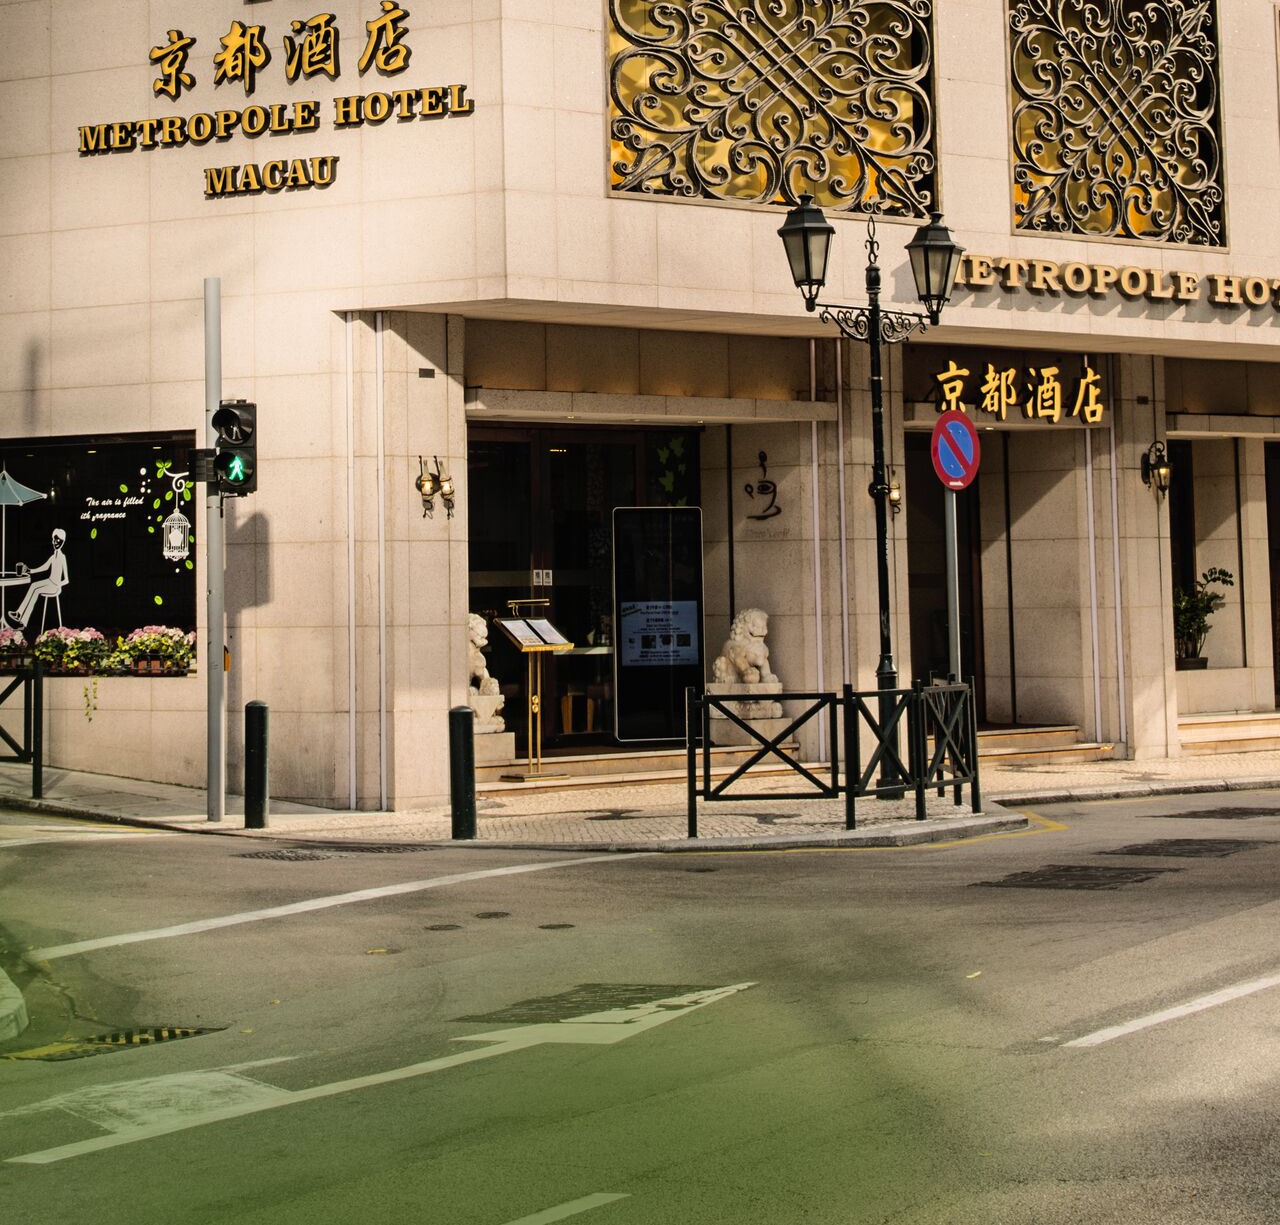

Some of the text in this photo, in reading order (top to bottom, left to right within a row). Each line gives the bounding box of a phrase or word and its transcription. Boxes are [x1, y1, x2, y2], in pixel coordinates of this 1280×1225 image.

[149, 0, 412, 99] 京都酒店
[78, 84, 474, 154] METROPOLE HOTEL
[204, 155, 339, 197] MACAU
[936, 360, 1104, 424] 京都酒店
[86, 496, 145, 508] The air is filled
